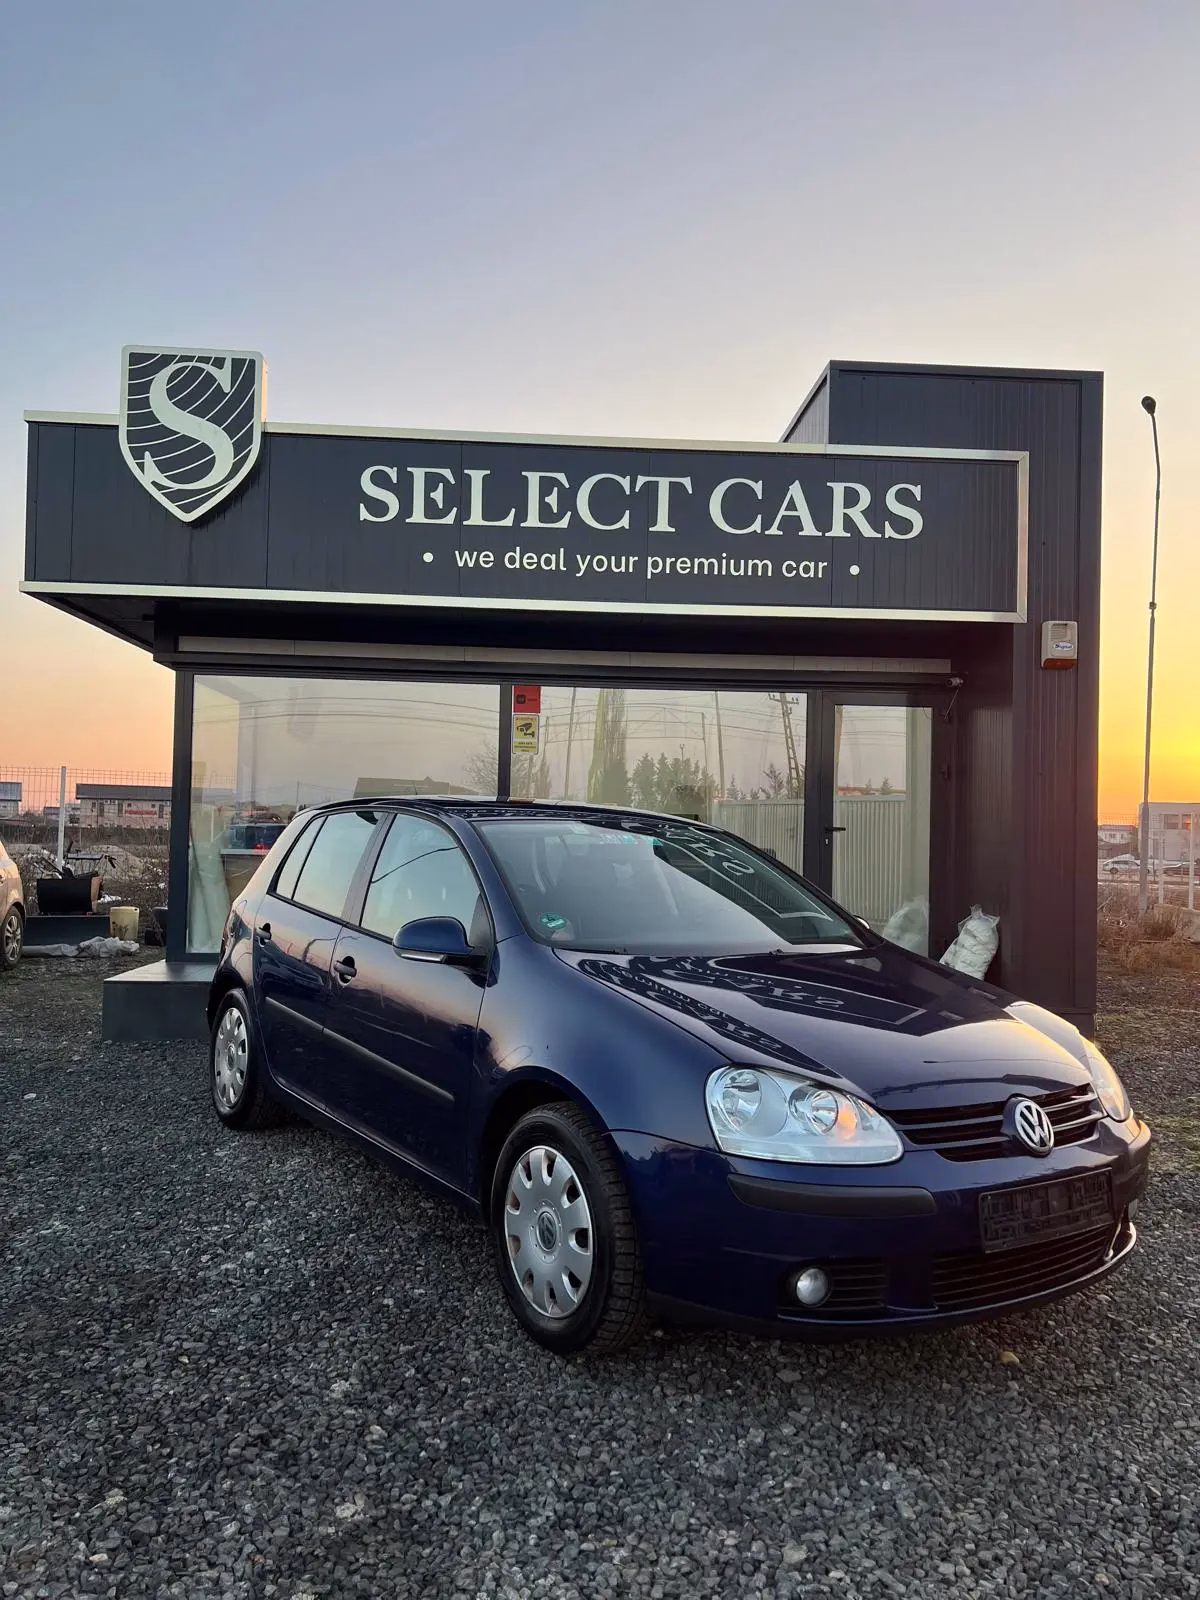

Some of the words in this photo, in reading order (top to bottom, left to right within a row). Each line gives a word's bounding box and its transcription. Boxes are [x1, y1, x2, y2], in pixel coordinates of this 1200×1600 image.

[144, 354, 234, 490] S
[359, 465, 693, 533] SELECT
[708, 477, 924, 540] CARS
[455, 550, 495, 569] we
[504, 547, 567, 572] deal
[575, 554, 639, 579] your
[646, 552, 773, 580] premium
[781, 560, 828, 579] car
